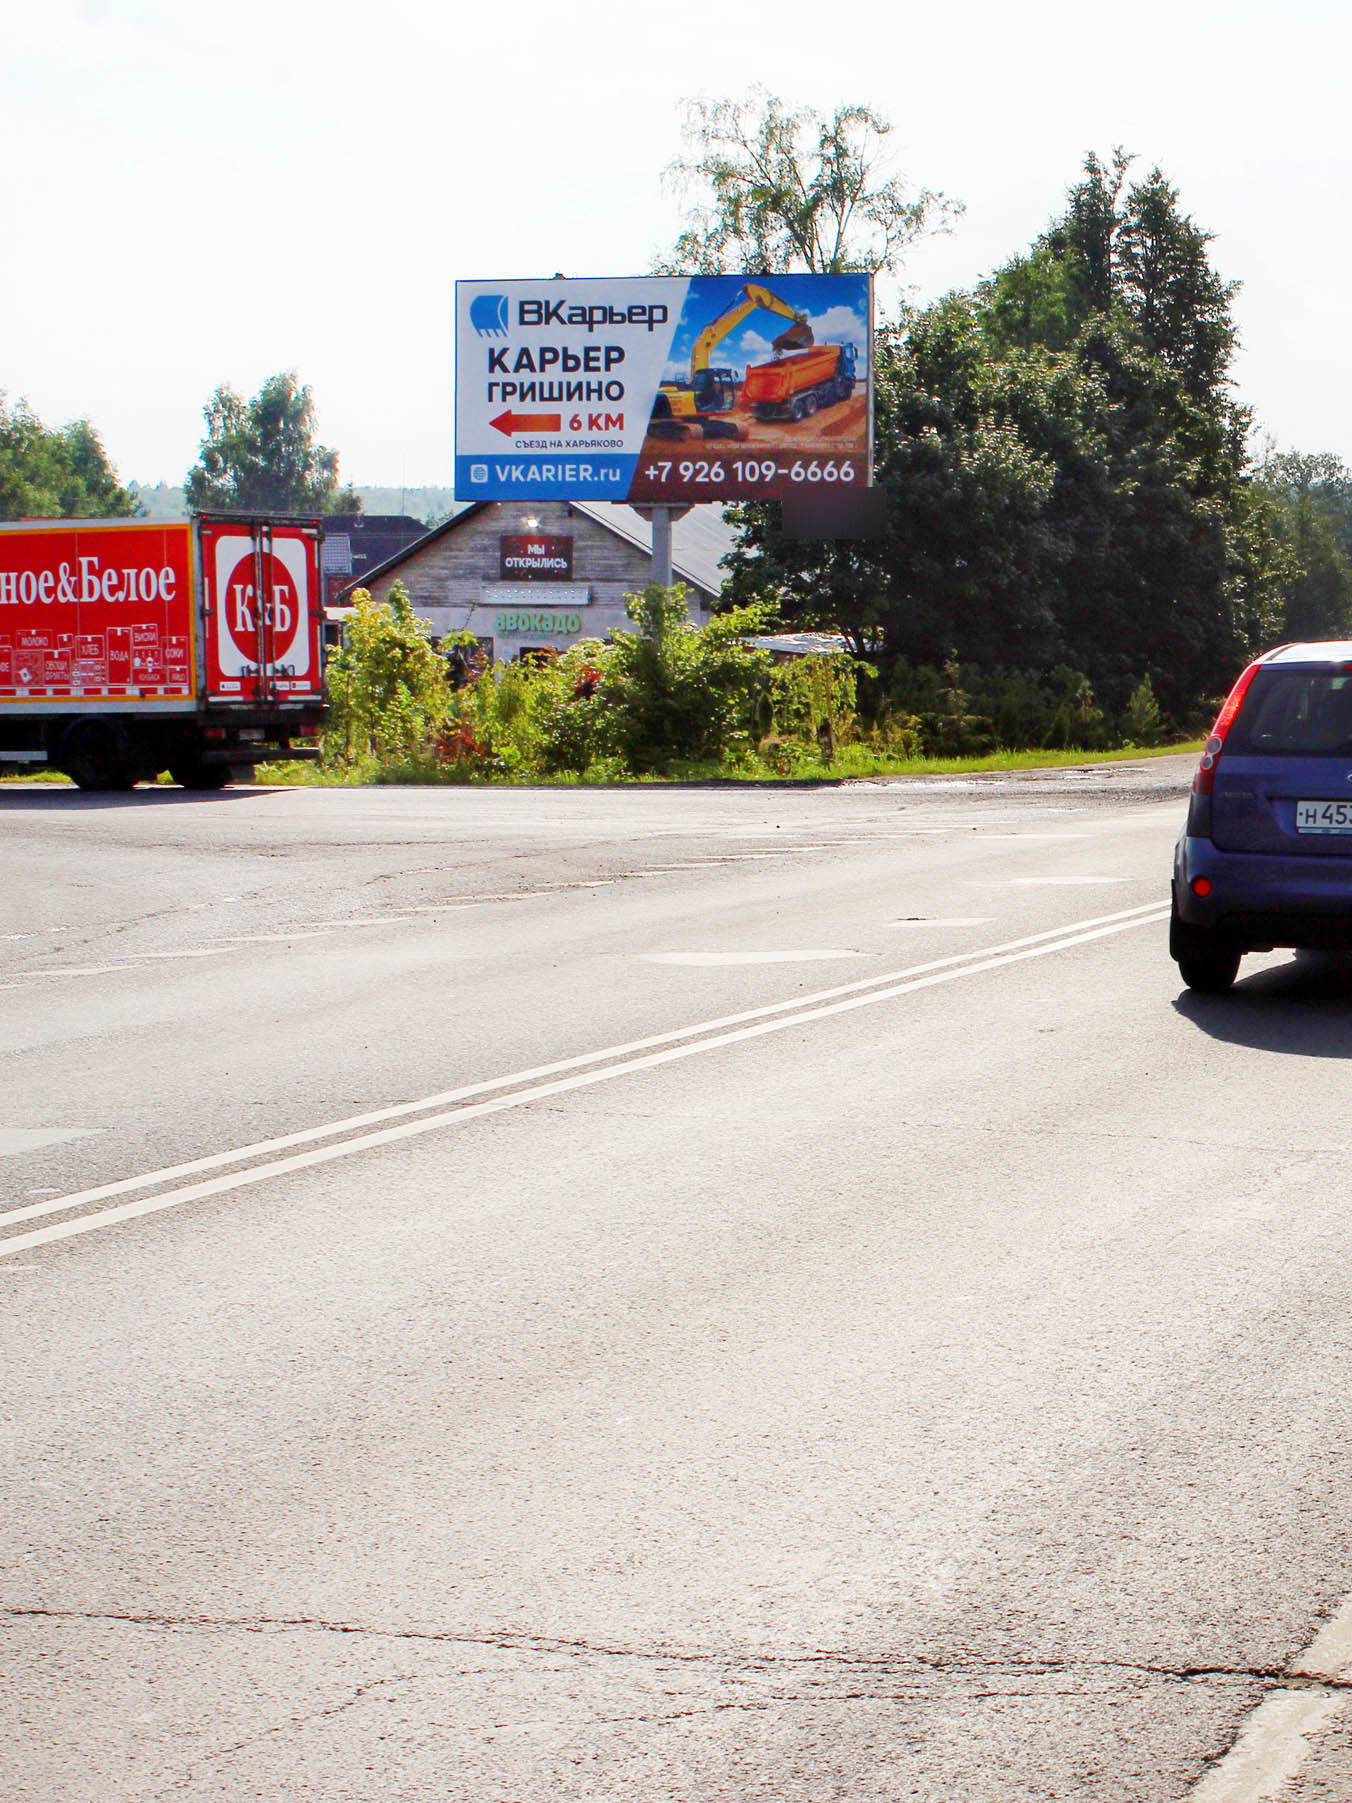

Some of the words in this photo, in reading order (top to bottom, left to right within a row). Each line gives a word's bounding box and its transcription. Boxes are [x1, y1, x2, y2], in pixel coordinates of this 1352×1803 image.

[518, 299, 669, 333] ВКарьер
[488, 345, 626, 374] КАРЬЕР
[487, 380, 625, 403] ГРИШИНО
[568, 413, 583, 431] 6
[587, 412, 625, 432] КМ
[515, 440, 548, 449] СЪЕЗД
[549, 440, 563, 449] НА
[564, 439, 624, 449] ХАРЬЯКОВО
[495, 464, 621, 482] VKARIER.ru
[644, 461, 673, 483] +7
[678, 461, 726, 483] 926
[732, 460, 856, 483] 109-6666
[527, 544, 546, 555] МЫ
[504, 557, 569, 569] ОТКРЫЛИСЬ
[80, 644, 100, 656] ХЛЕБ
[110, 650, 129, 662] ВОДА
